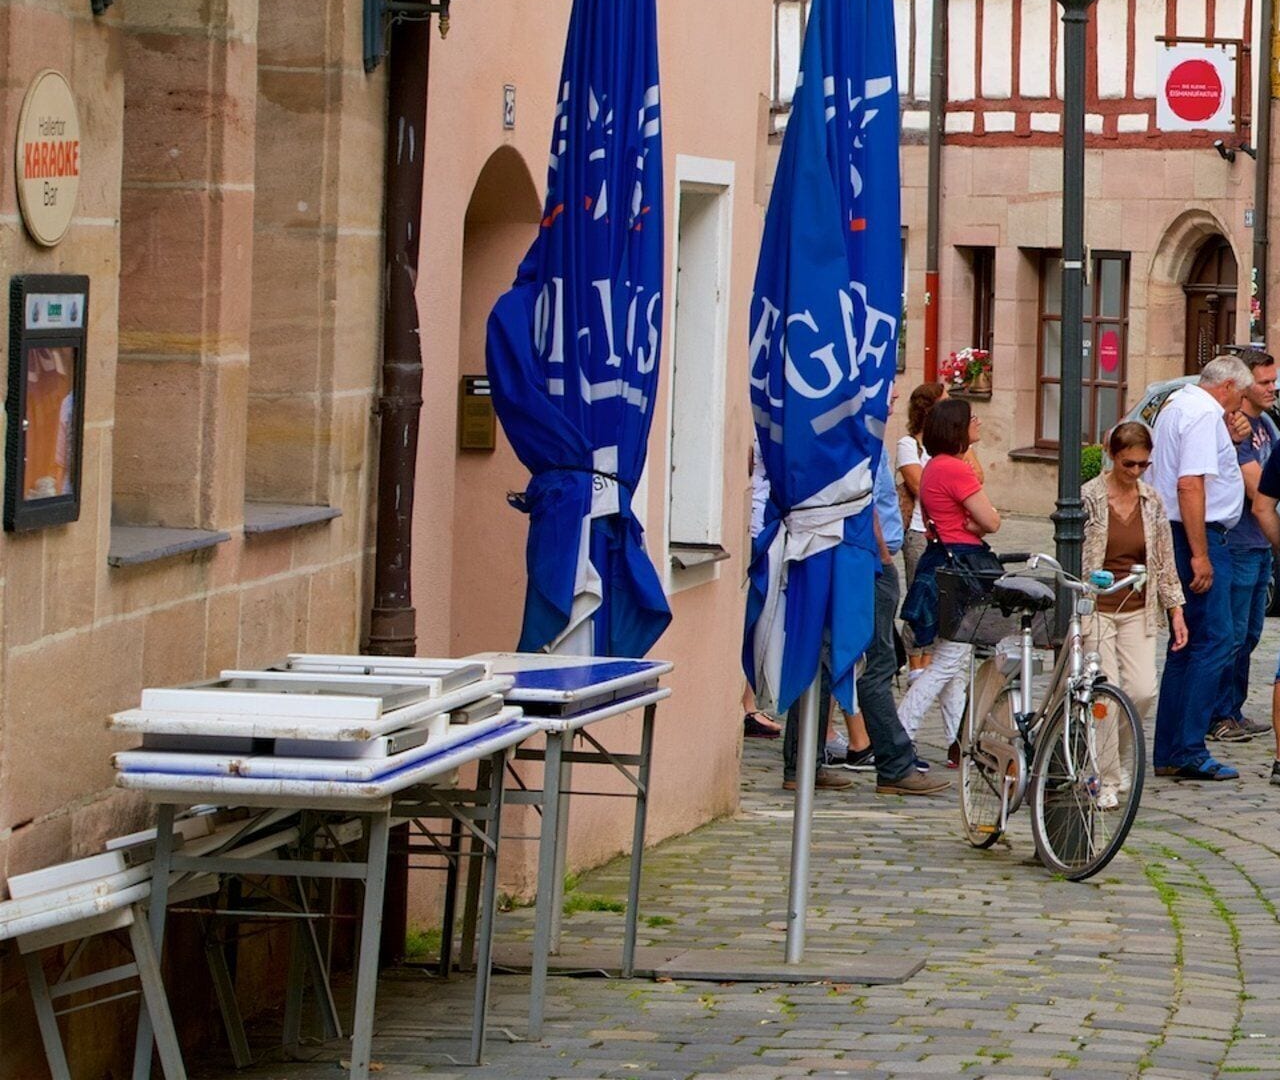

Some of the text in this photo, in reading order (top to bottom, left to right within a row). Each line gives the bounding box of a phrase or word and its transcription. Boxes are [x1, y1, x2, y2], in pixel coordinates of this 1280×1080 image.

[1169, 90, 1219, 98] EISMANUFAKTUR
[24, 140, 80, 180] KARAOKE
[43, 181, 59, 207] Bar
